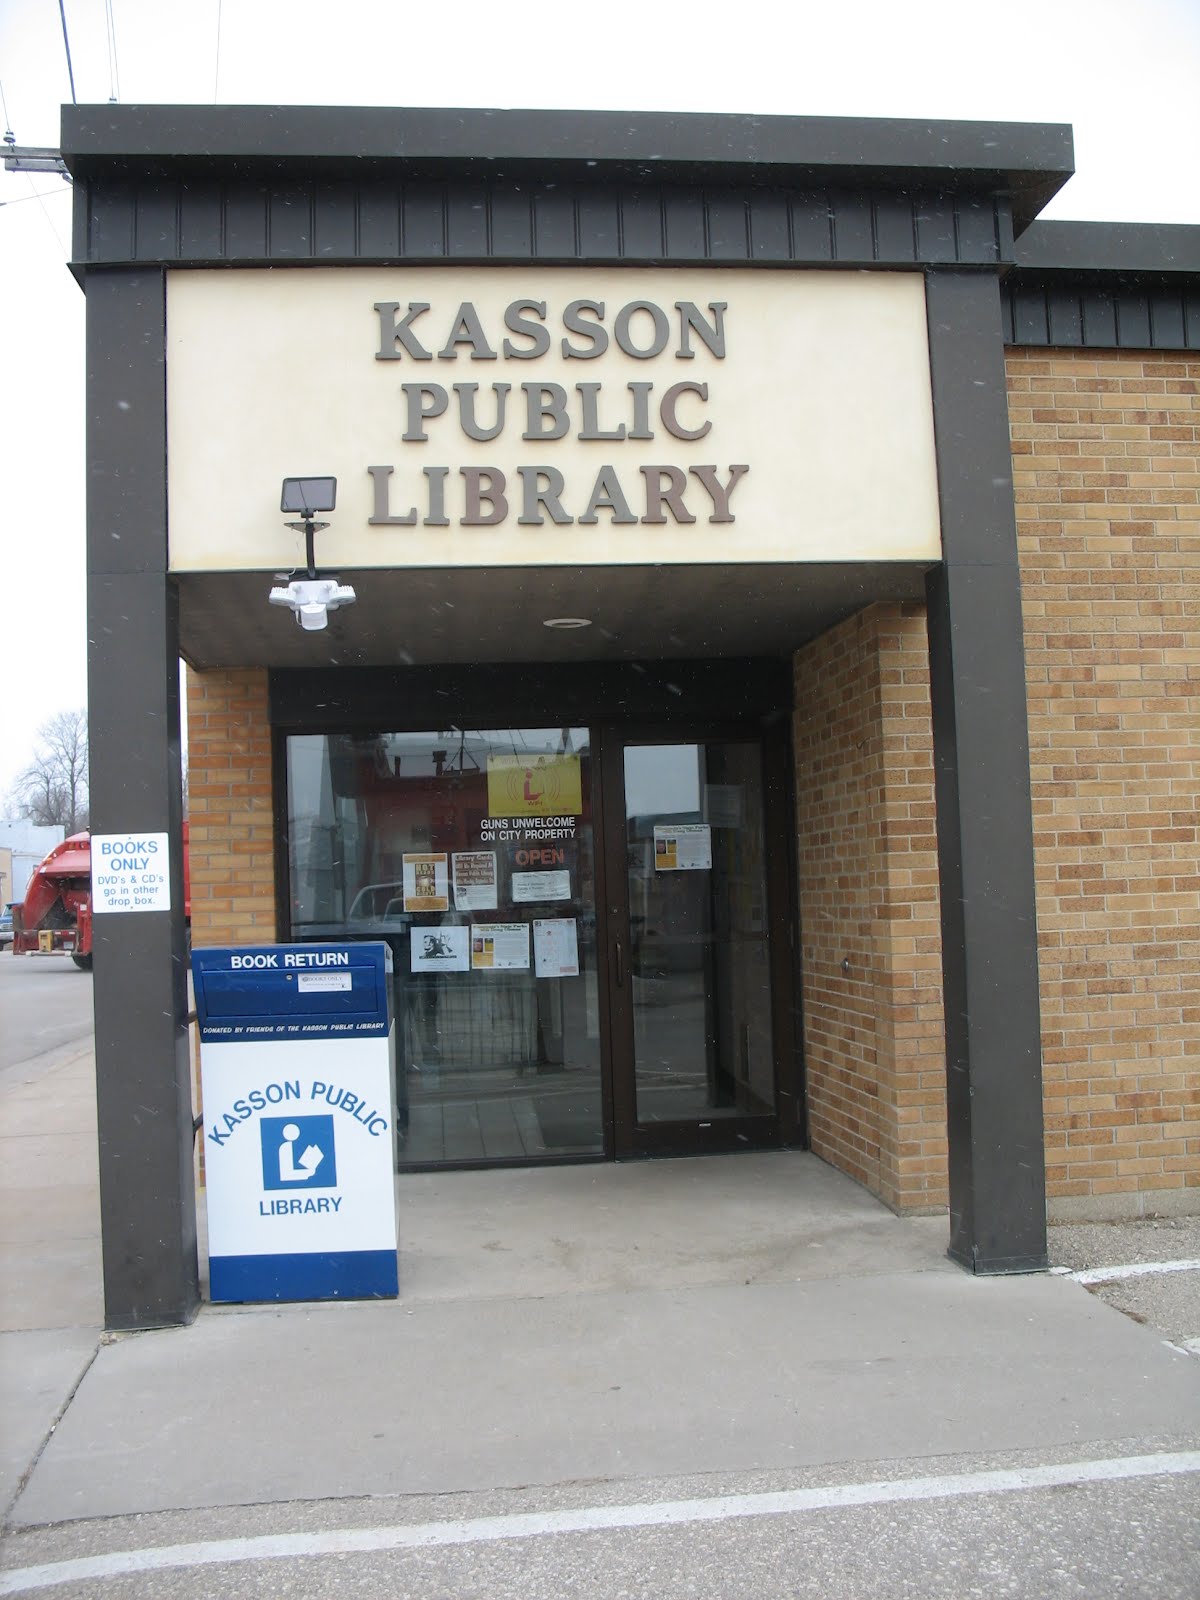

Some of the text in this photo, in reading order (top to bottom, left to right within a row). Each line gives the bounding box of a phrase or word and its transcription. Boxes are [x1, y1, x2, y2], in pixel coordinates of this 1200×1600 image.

[373, 299, 728, 361] KASSON
[401, 381, 713, 441] PUBLIC
[367, 464, 750, 525] LIBRARY
[480, 816, 575, 830] GUNS UNWELCOME
[480, 828, 576, 841] ON CITY PROPERTY
[101, 841, 158, 855] BOOKS
[110, 857, 149, 871] ONLY
[515, 848, 565, 866] OPEN
[98, 874, 164, 885] DVD's & CD's
[104, 885, 159, 897] go in other
[108, 895, 156, 907] drop box.
[231, 952, 349, 969] BOOK RETURN
[356, 1022, 385, 1030] LIBRARY
[208, 1080, 388, 1147] KASSON PUBLIC
[259, 1196, 342, 1216] LIBRARY
